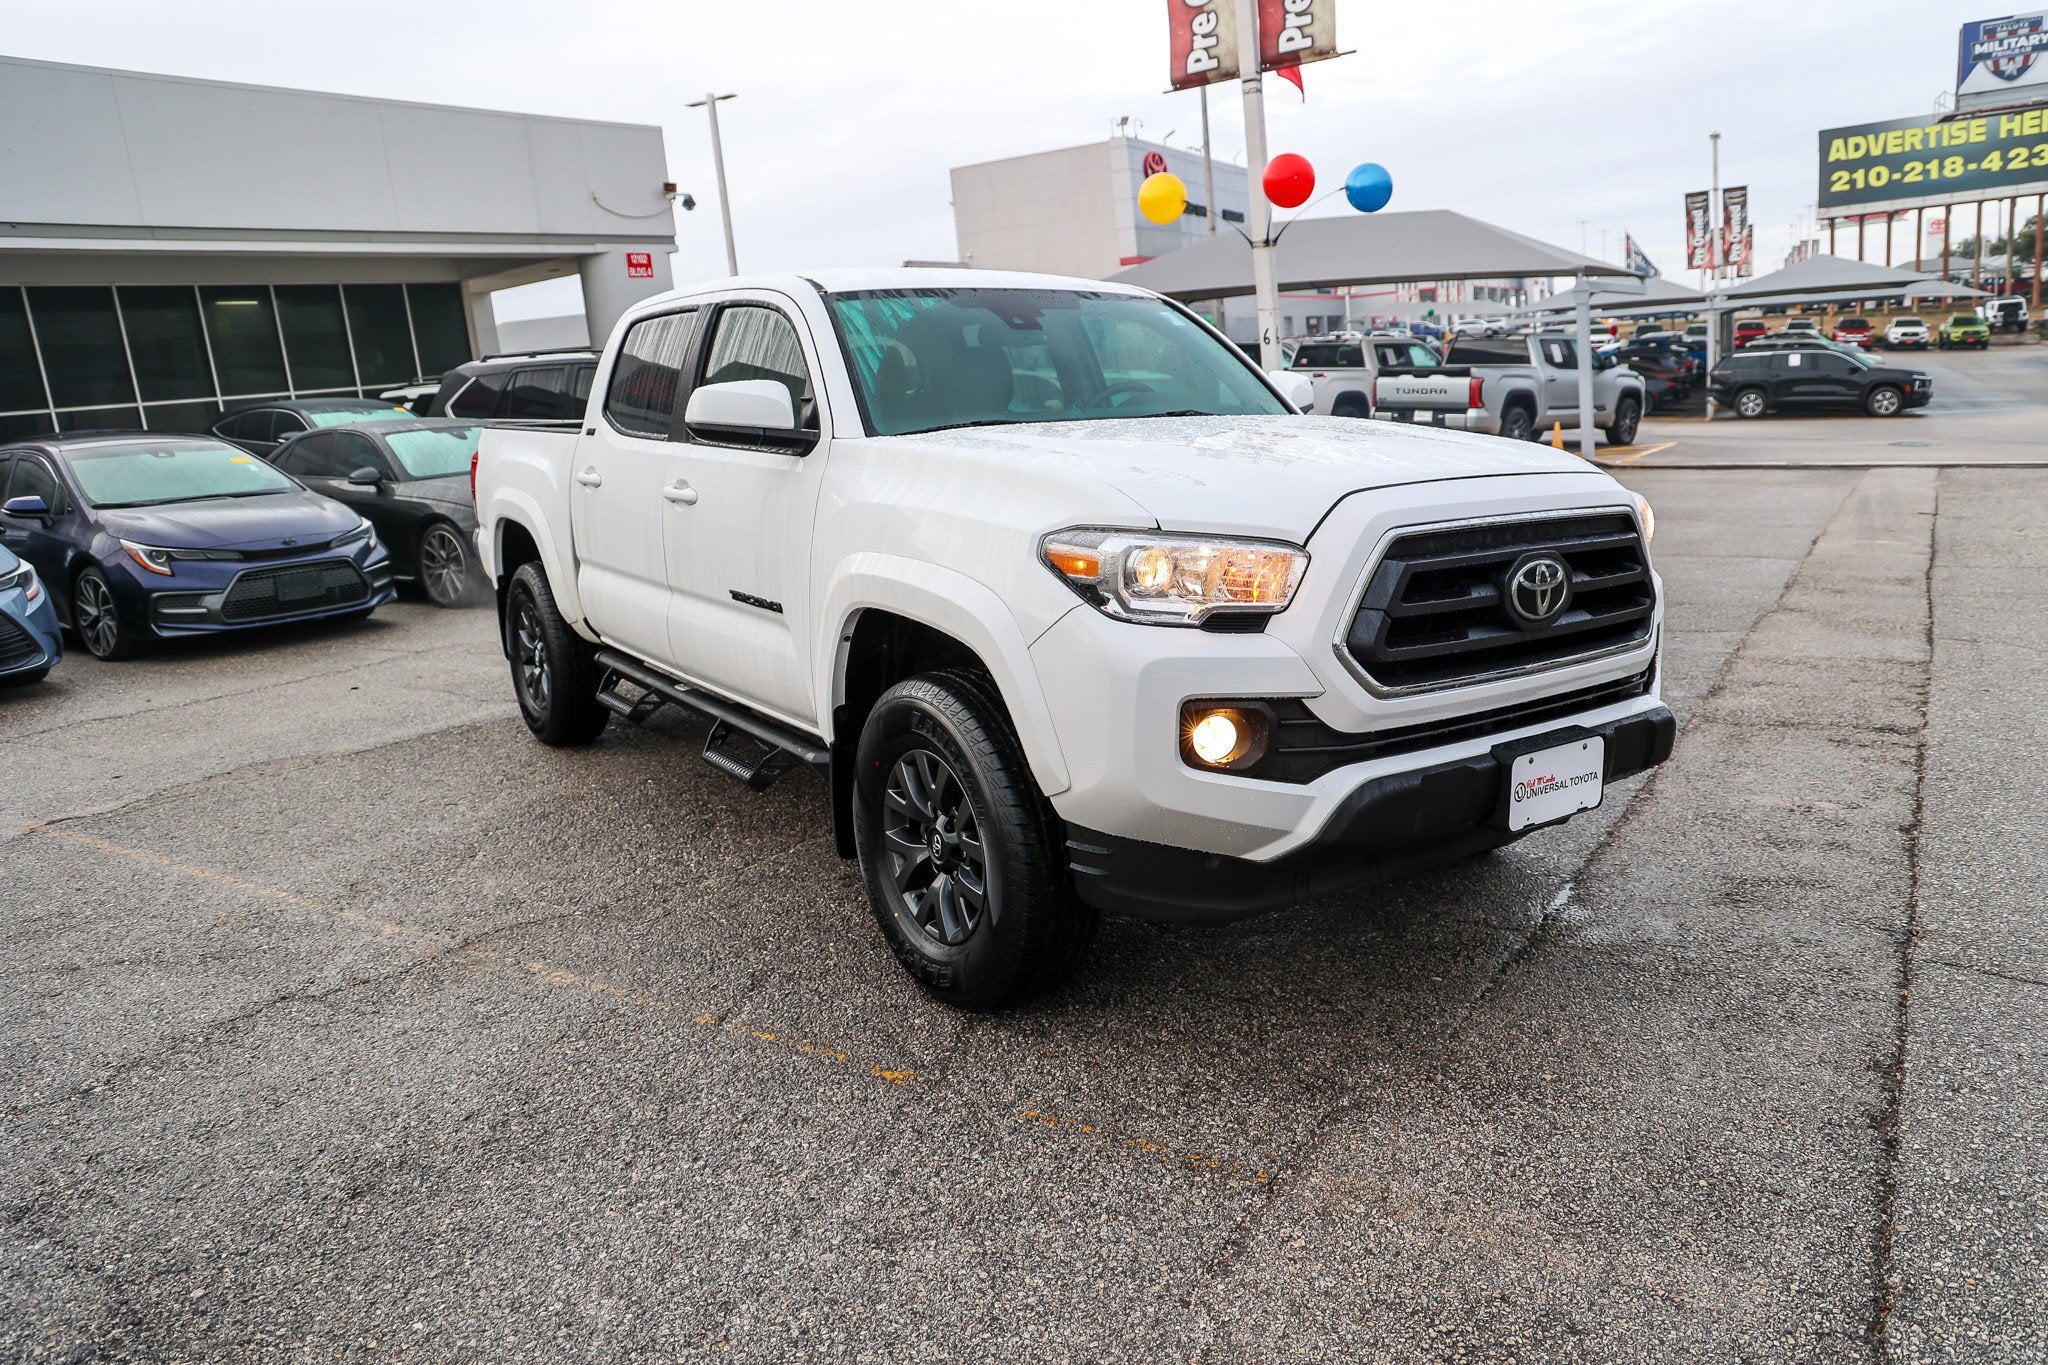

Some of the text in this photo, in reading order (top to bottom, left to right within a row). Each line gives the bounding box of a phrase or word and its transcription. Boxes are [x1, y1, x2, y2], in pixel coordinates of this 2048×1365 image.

[1186, 11, 1219, 75] Pre
[1974, 32, 2048, 55] MILITARY
[1827, 118, 1987, 163] ADVERTISE
[1263, 327, 1271, 345] 6
[1395, 387, 1448, 395] TUNDRA
[1526, 771, 1598, 799] UNIVERSAL TOYOTA
